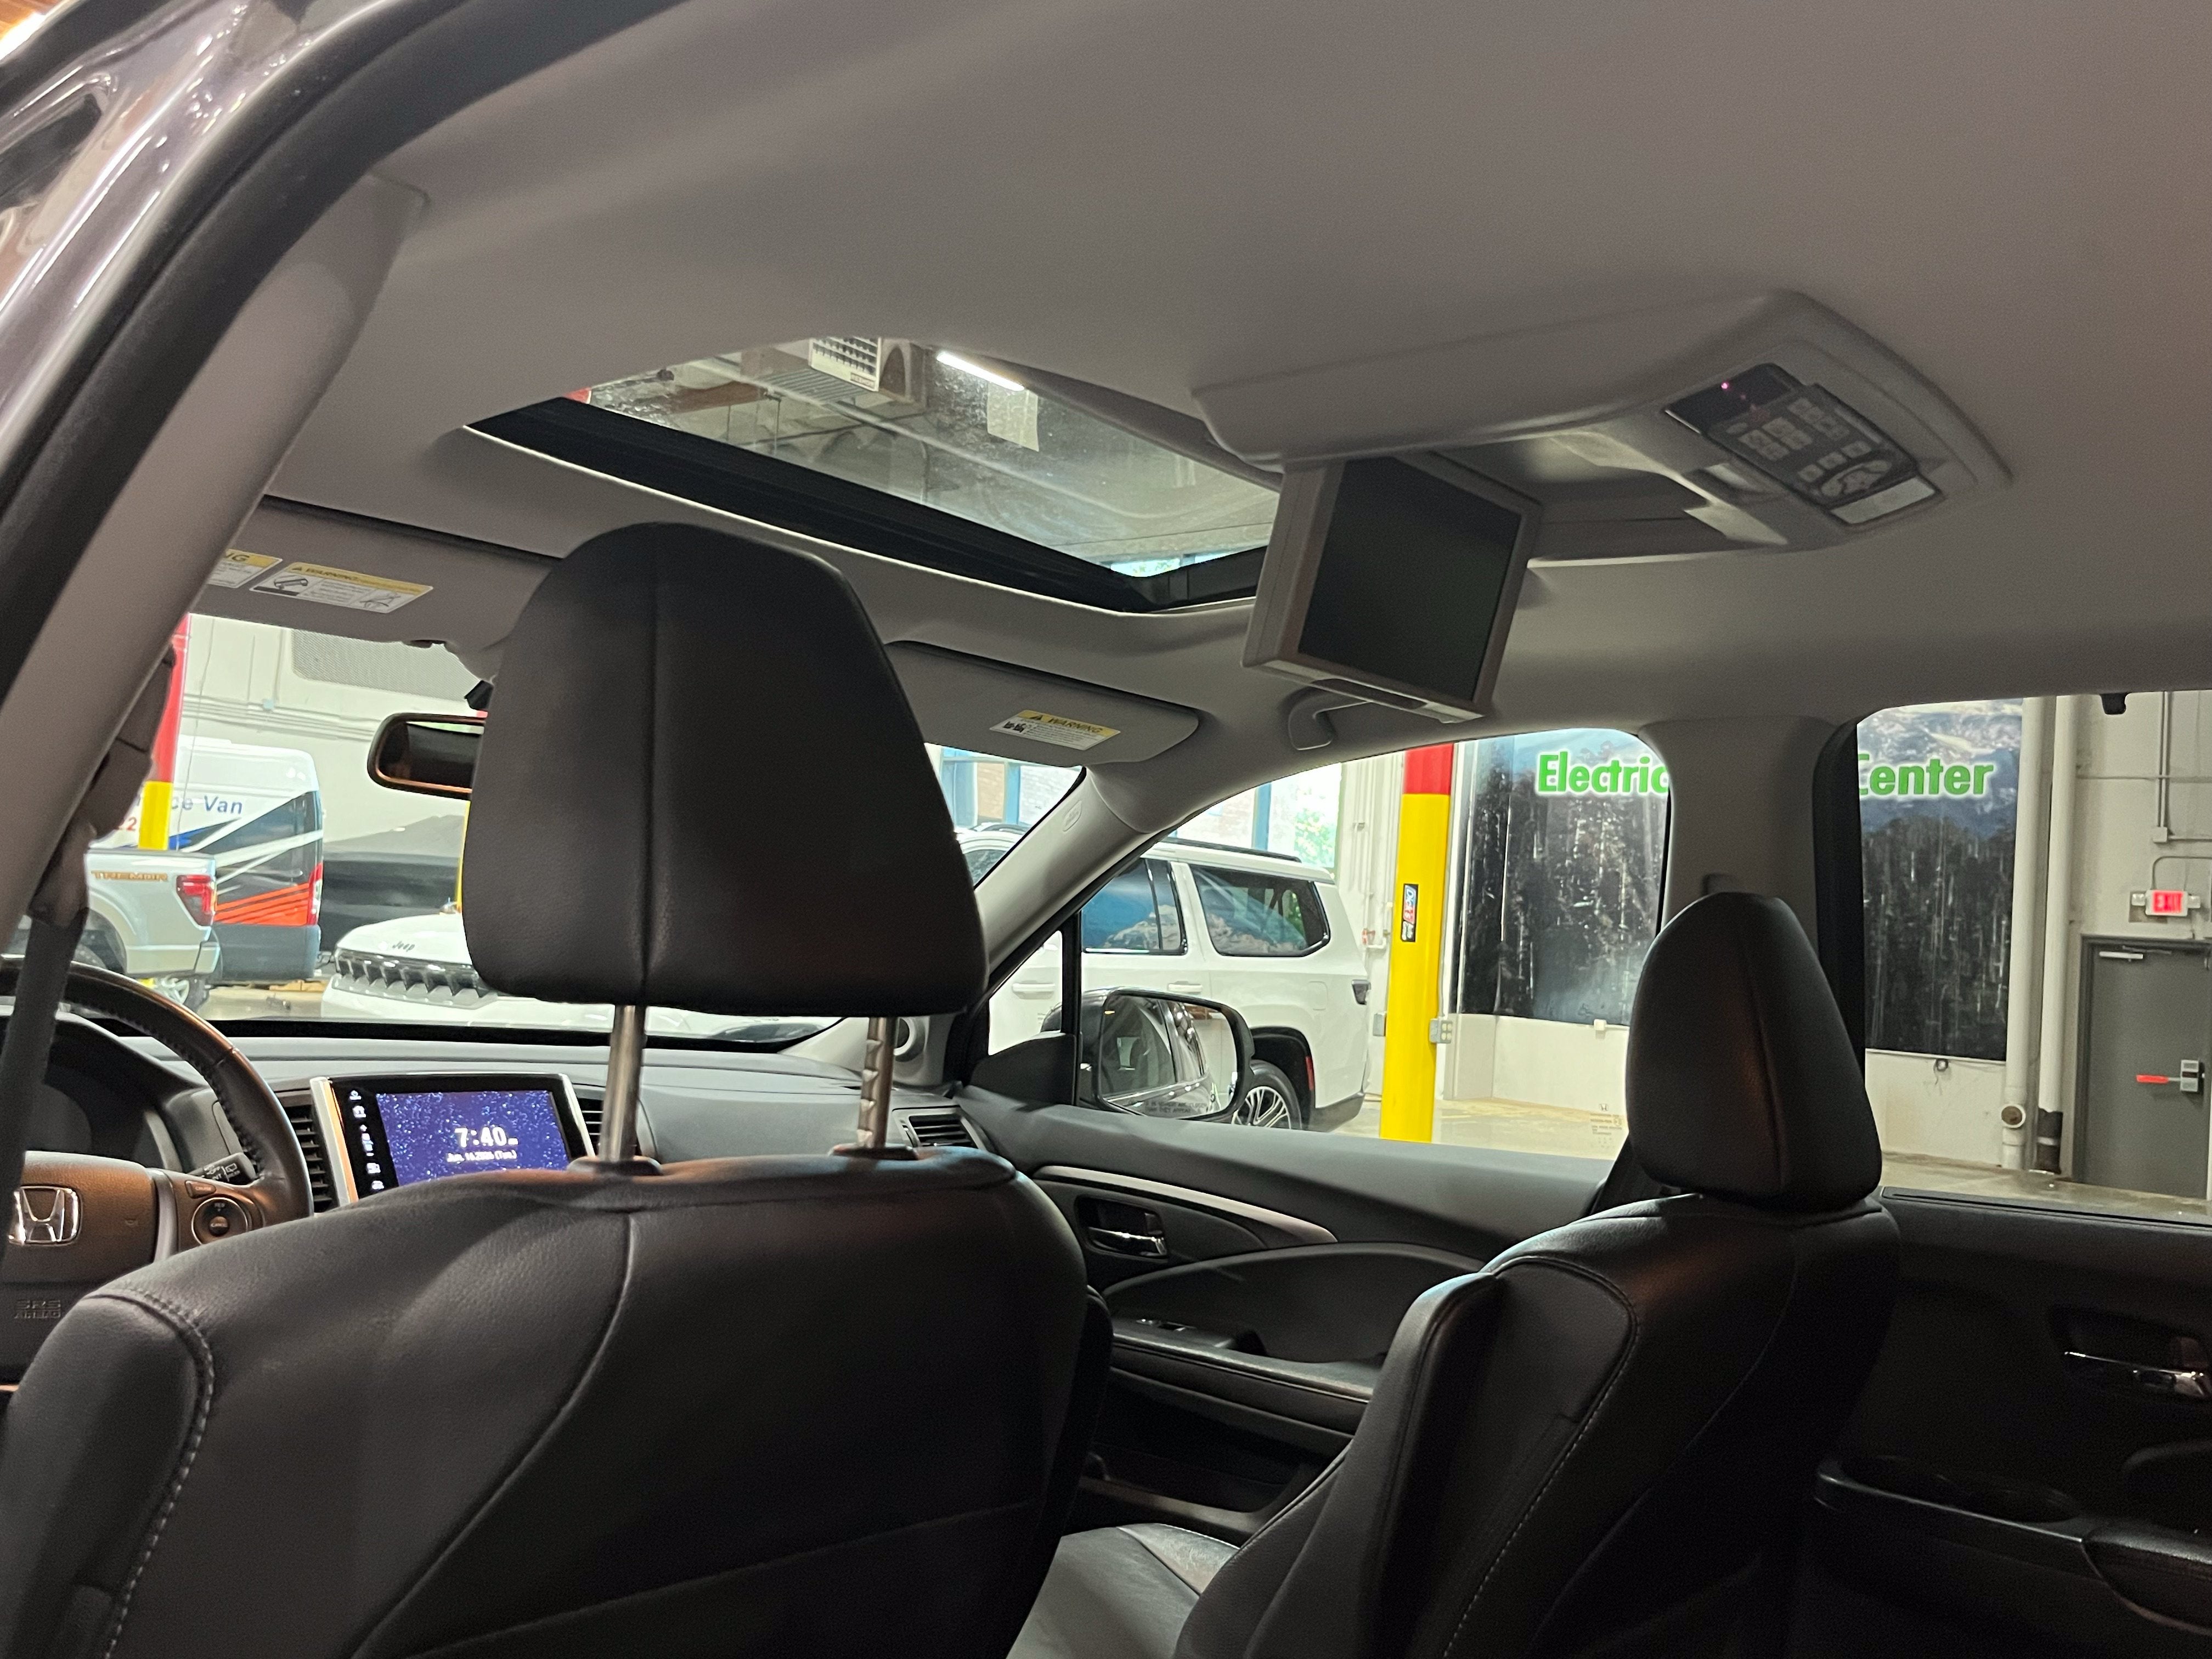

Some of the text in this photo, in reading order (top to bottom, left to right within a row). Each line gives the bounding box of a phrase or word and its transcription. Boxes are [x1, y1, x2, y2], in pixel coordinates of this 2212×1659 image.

[1047, 718, 1103, 733] WARNING
[1538, 751, 1669, 793] Electric
[204, 795, 243, 815] Van
[392, 940, 415, 952] Jeep
[454, 1126, 507, 1148] 7:40
